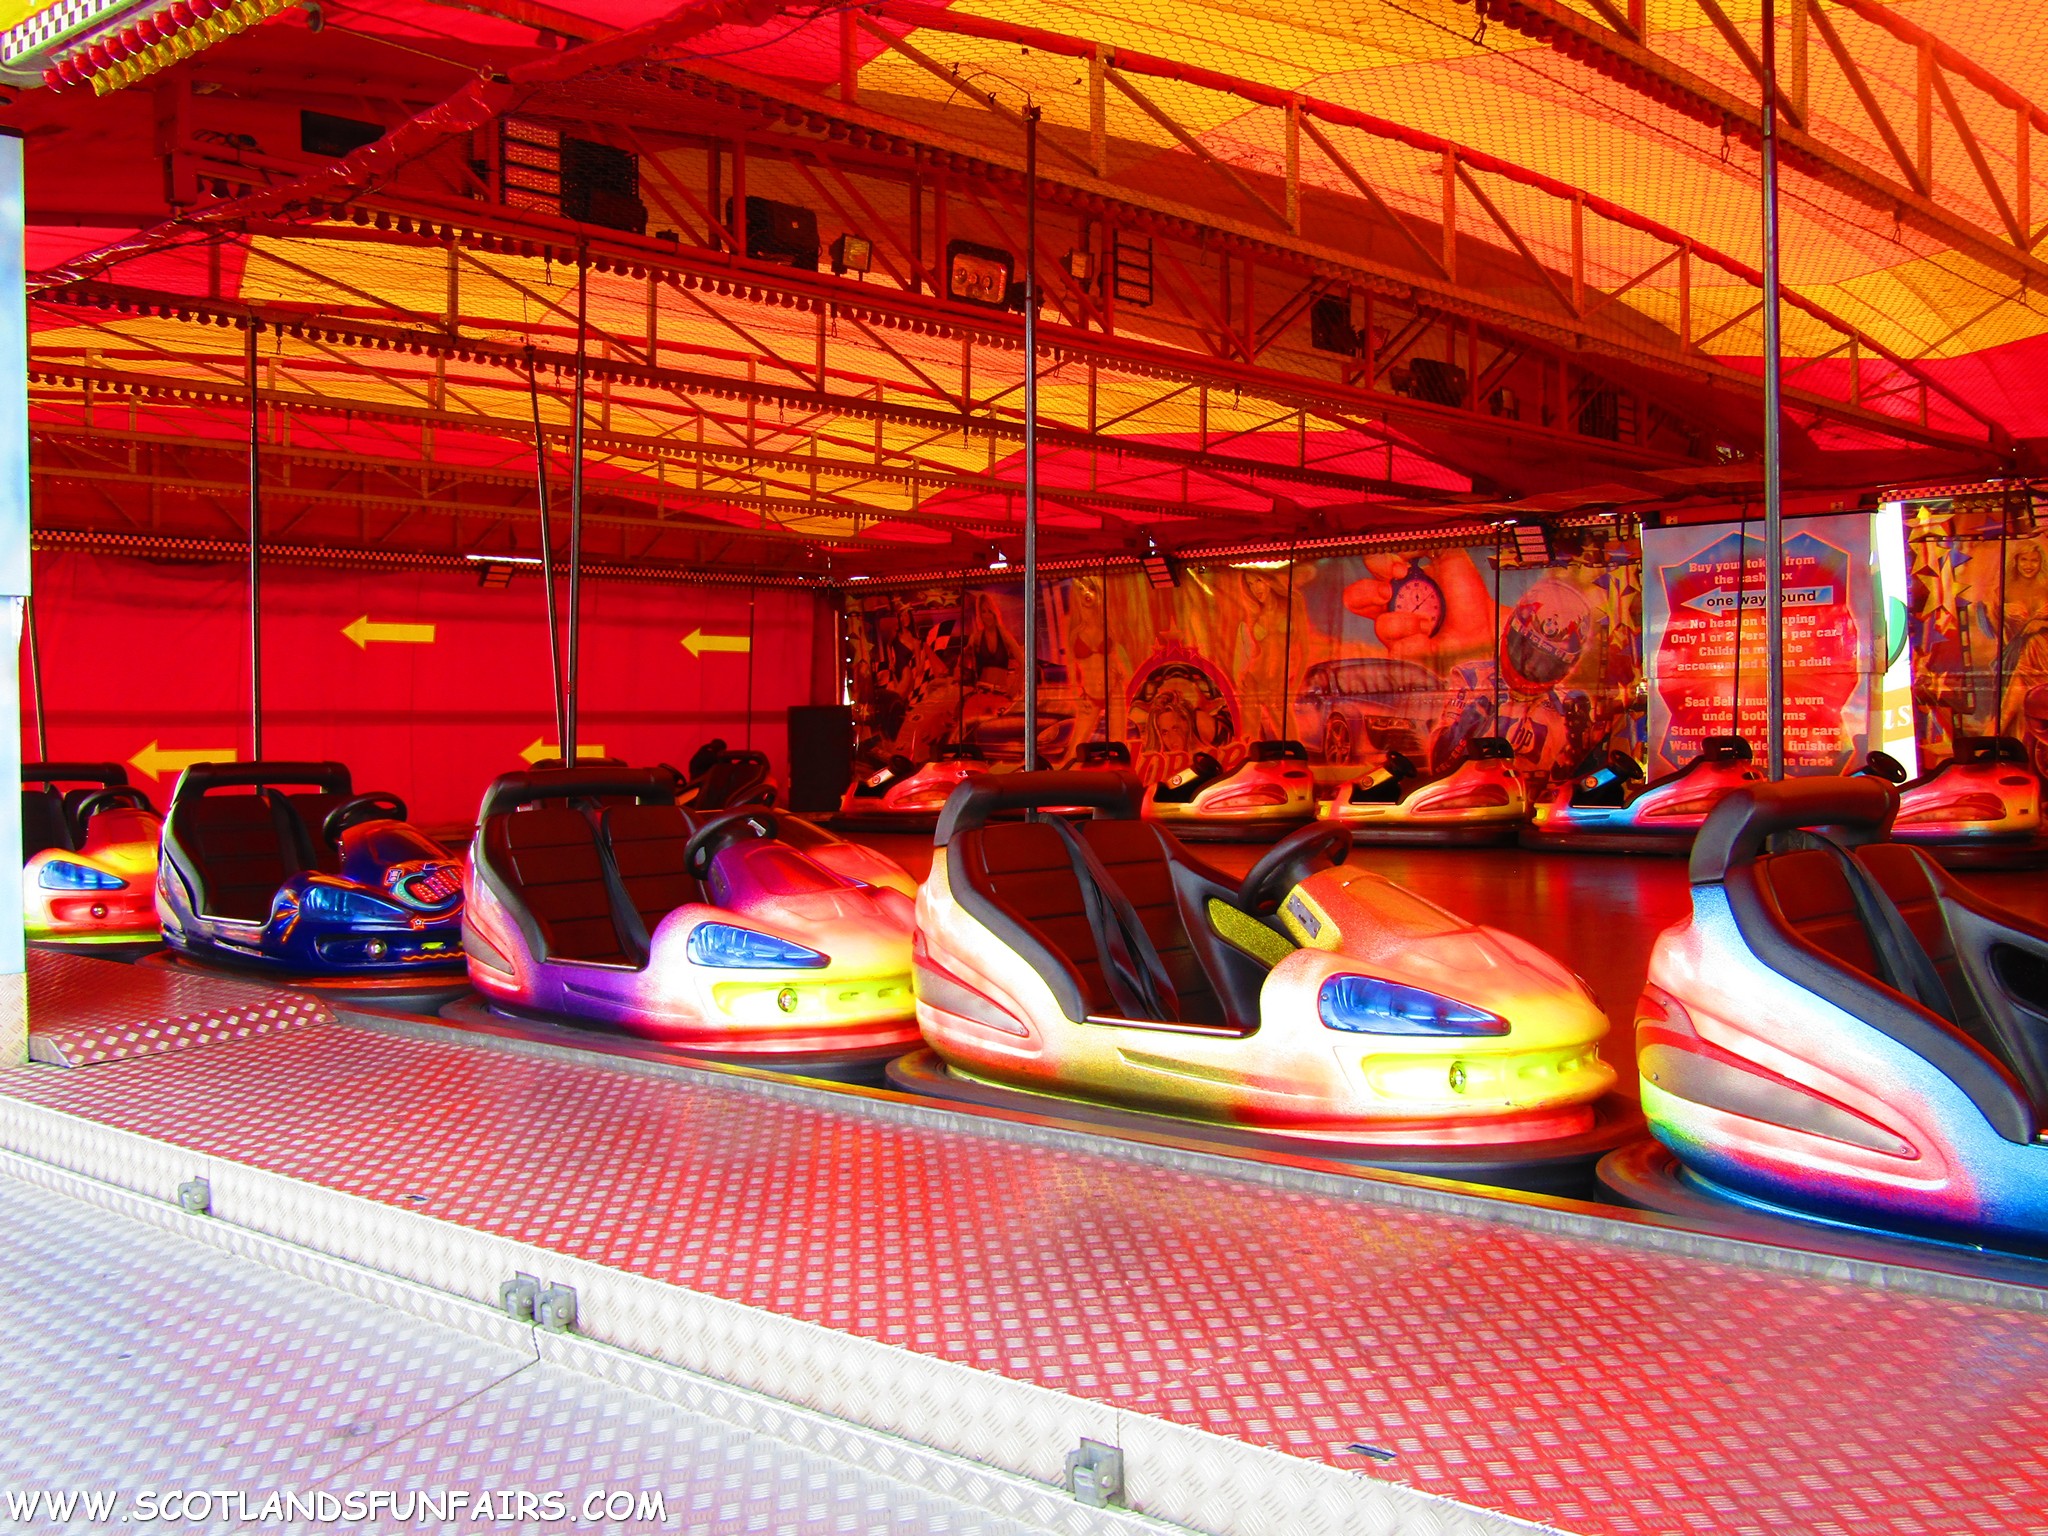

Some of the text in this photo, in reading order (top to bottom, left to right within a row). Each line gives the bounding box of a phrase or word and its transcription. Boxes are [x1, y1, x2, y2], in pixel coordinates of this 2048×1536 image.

[1689, 562, 1712, 573] Buy
[1785, 556, 1816, 566] from
[1714, 574, 1734, 585] the
[1706, 590, 1816, 607] one way ound
[1689, 619, 1706, 629] No
[1709, 616, 1738, 628] head
[1742, 618, 1758, 626] on
[1670, 633, 1697, 645] Only
[1700, 632, 1706, 643] 1
[1709, 634, 1722, 642] or
[1725, 631, 1735, 642] 2
[1740, 630, 1788, 641] Perss
[1791, 629, 1812, 641] per
[1699, 646, 1750, 657] Childrn
[1787, 643, 1803, 653] be
[1782, 659, 1796, 668] an
[1799, 656, 1832, 667] adult
[1684, 696, 1710, 707] Seat
[1745, 697, 1767, 706] mus
[1794, 696, 1824, 705] worn
[1702, 710, 1807, 721] unde both rms
[1670, 726, 1706, 736] Stand
[1744, 726, 1757, 736] of
[1812, 726, 1841, 736] cars
[1669, 740, 1697, 751] Wait
[1749, 740, 1769, 751] ide
[1788, 740, 1842, 751] finished
[1799, 756, 1834, 766] track
